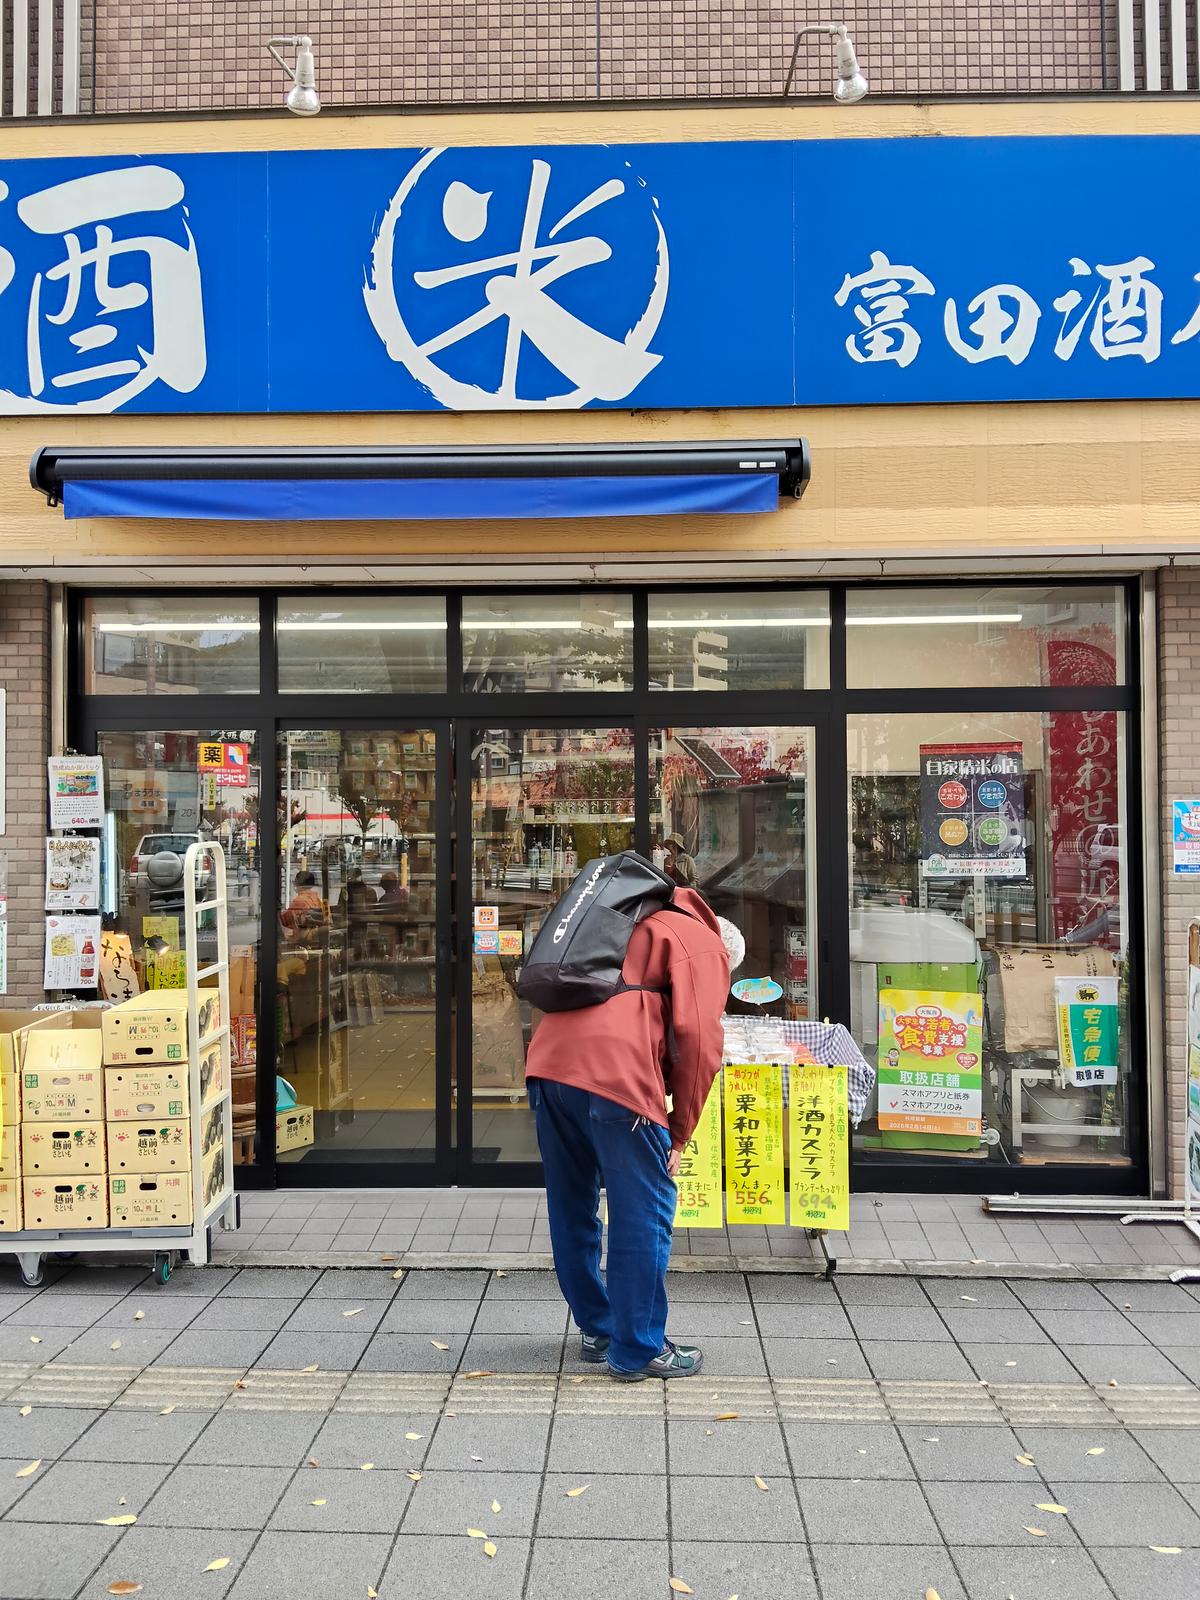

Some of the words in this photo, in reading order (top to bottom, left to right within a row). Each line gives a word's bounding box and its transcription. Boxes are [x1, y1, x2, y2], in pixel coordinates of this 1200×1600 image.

[413, 158, 664, 402] 米
[926, 758, 1018, 776] 自家精米の店
[980, 792, 1004, 800] つきたて
[553, 861, 606, 944] Champion
[897, 1026, 964, 1049] 食費支援
[1083, 1008, 1102, 1063] 宅急便
[922, 1045, 944, 1056] 事業
[899, 1070, 960, 1087] 取扱店舗
[1076, 1069, 1104, 1081] 取扱店
[902, 1089, 970, 1101] スマホアプリと紙券
[67, 1098, 76, 1107] M
[902, 1100, 962, 1111] スマホアプリのみ
[733, 1094, 760, 1178] 栗和菓子
[797, 1094, 826, 1180] 洋酒カステラ
[52, 1140, 72, 1150] 越前
[138, 1138, 157, 1148] 越前
[52, 1150, 72, 1158] さといも
[138, 1148, 157, 1156] さといも
[54, 1194, 74, 1204] 越前
[54, 1204, 74, 1212] さといも
[155, 1204, 161, 1213] L
